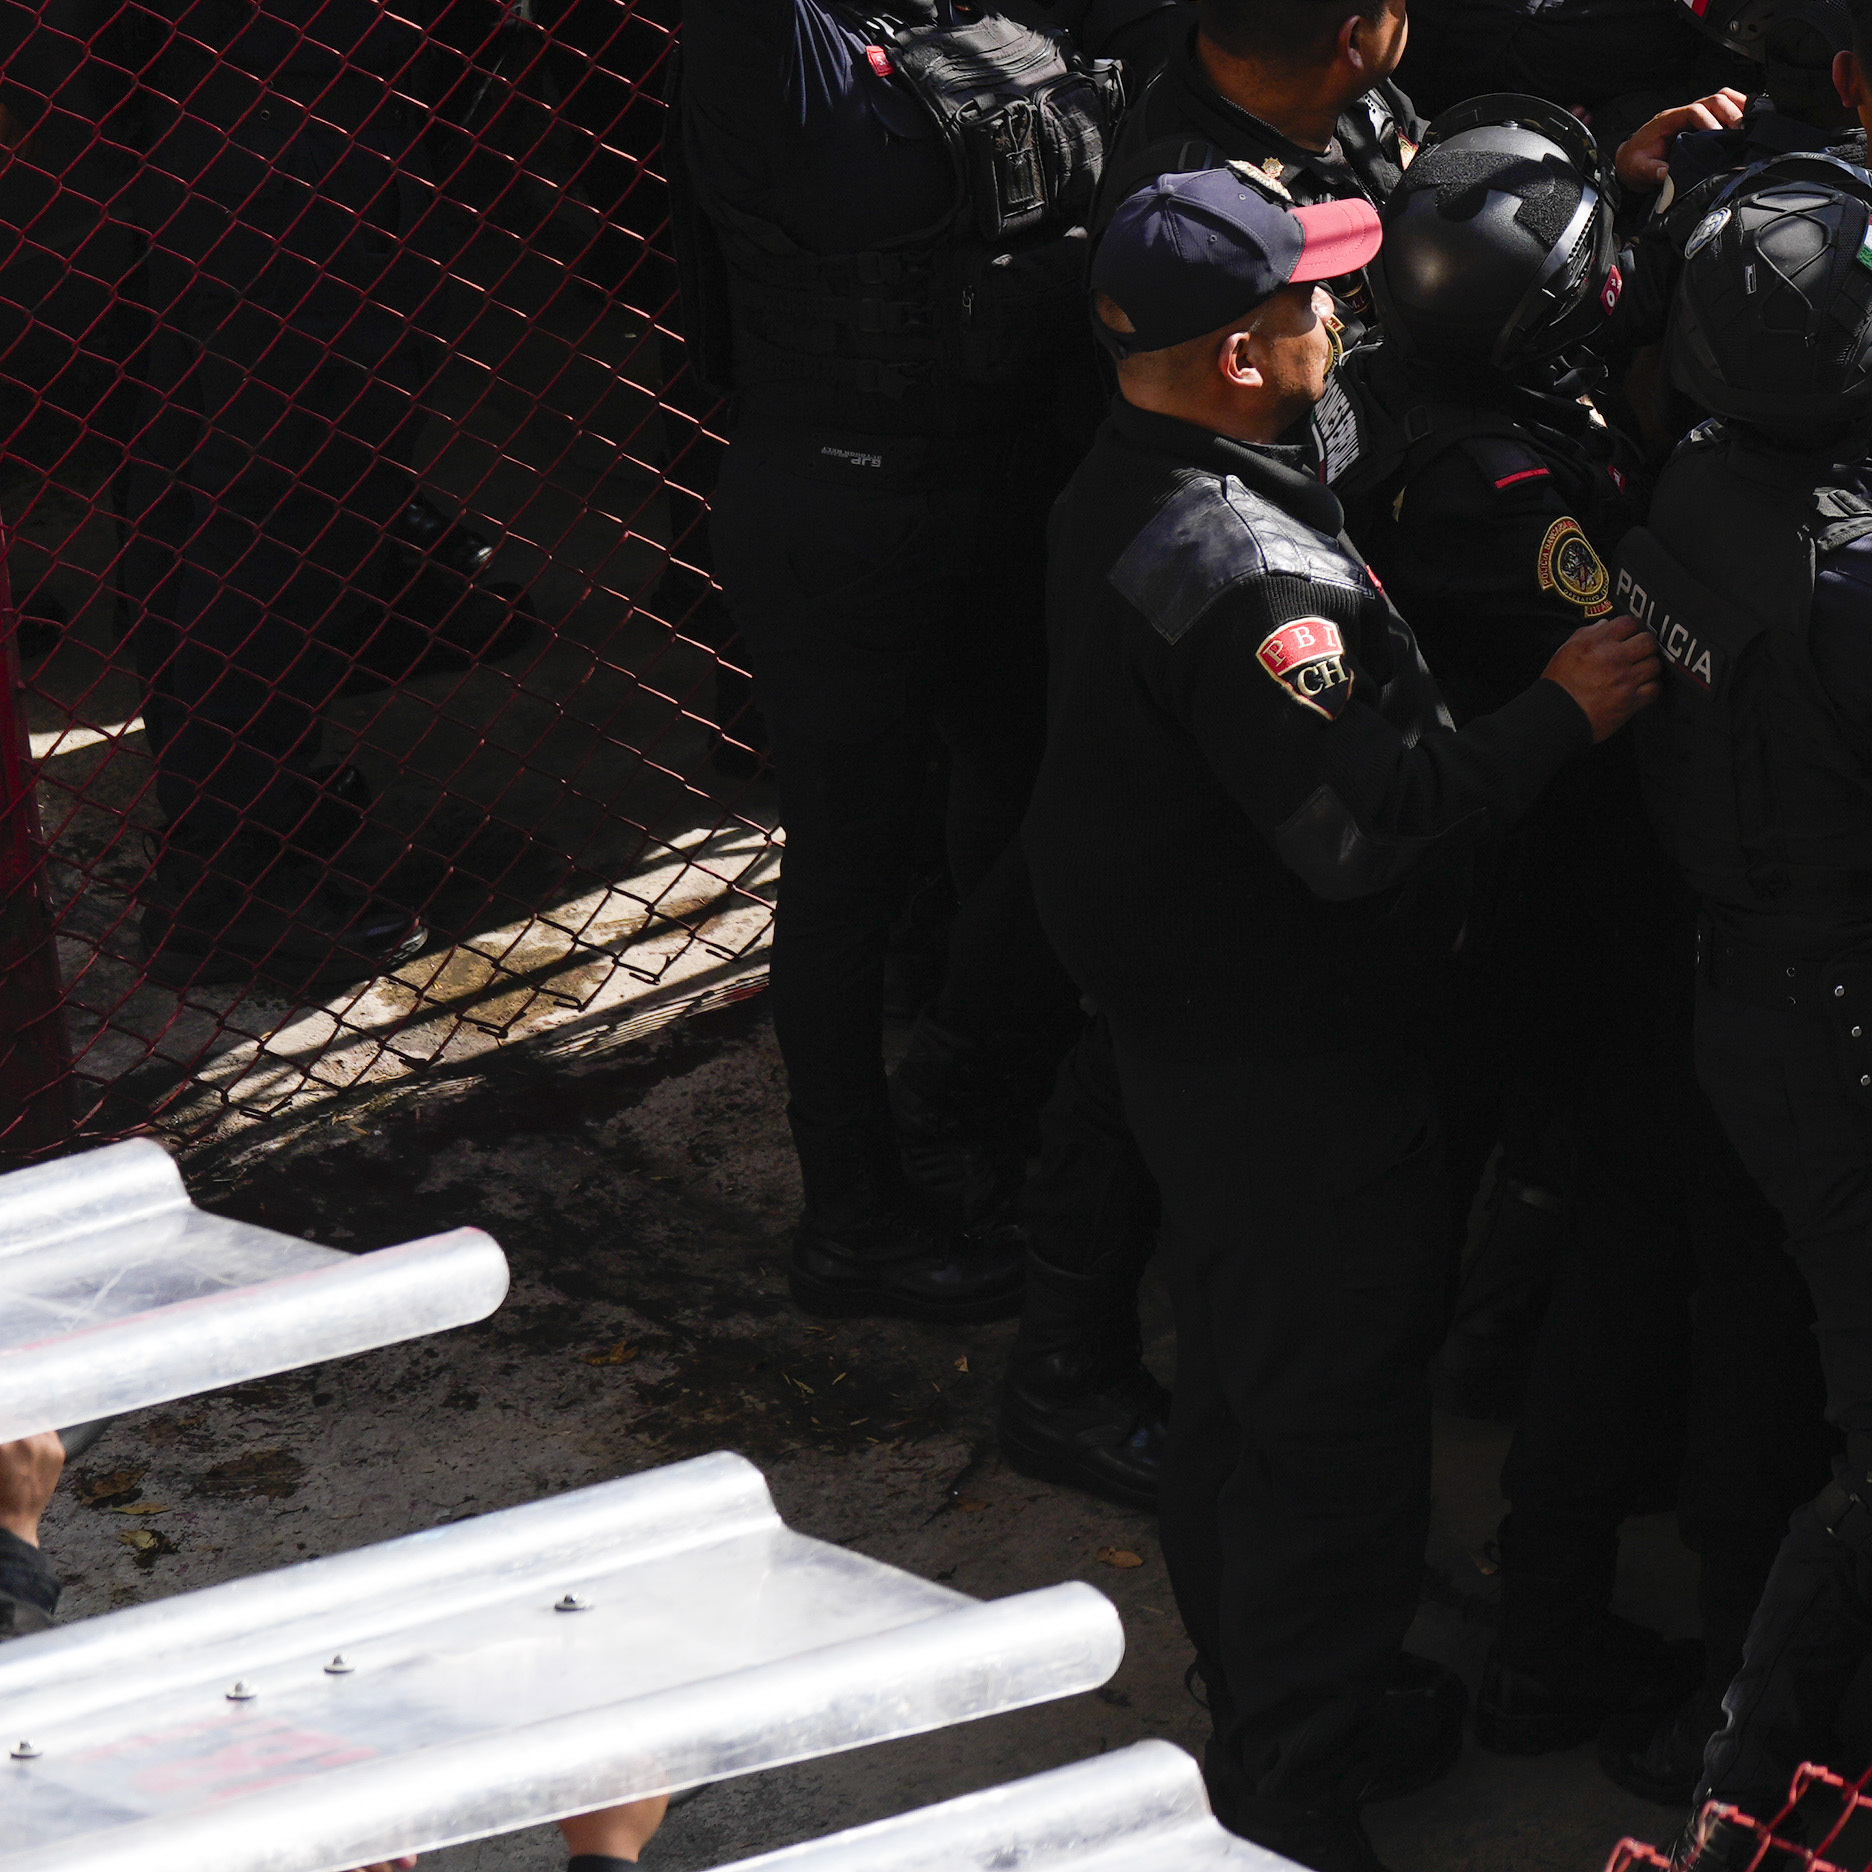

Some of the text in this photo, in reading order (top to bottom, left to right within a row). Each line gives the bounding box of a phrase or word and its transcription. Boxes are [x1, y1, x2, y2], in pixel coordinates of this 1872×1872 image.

[1262, 625, 1339, 669] PBI
[1616, 567, 1715, 685] POLICIA
[1296, 657, 1349, 696] CH
